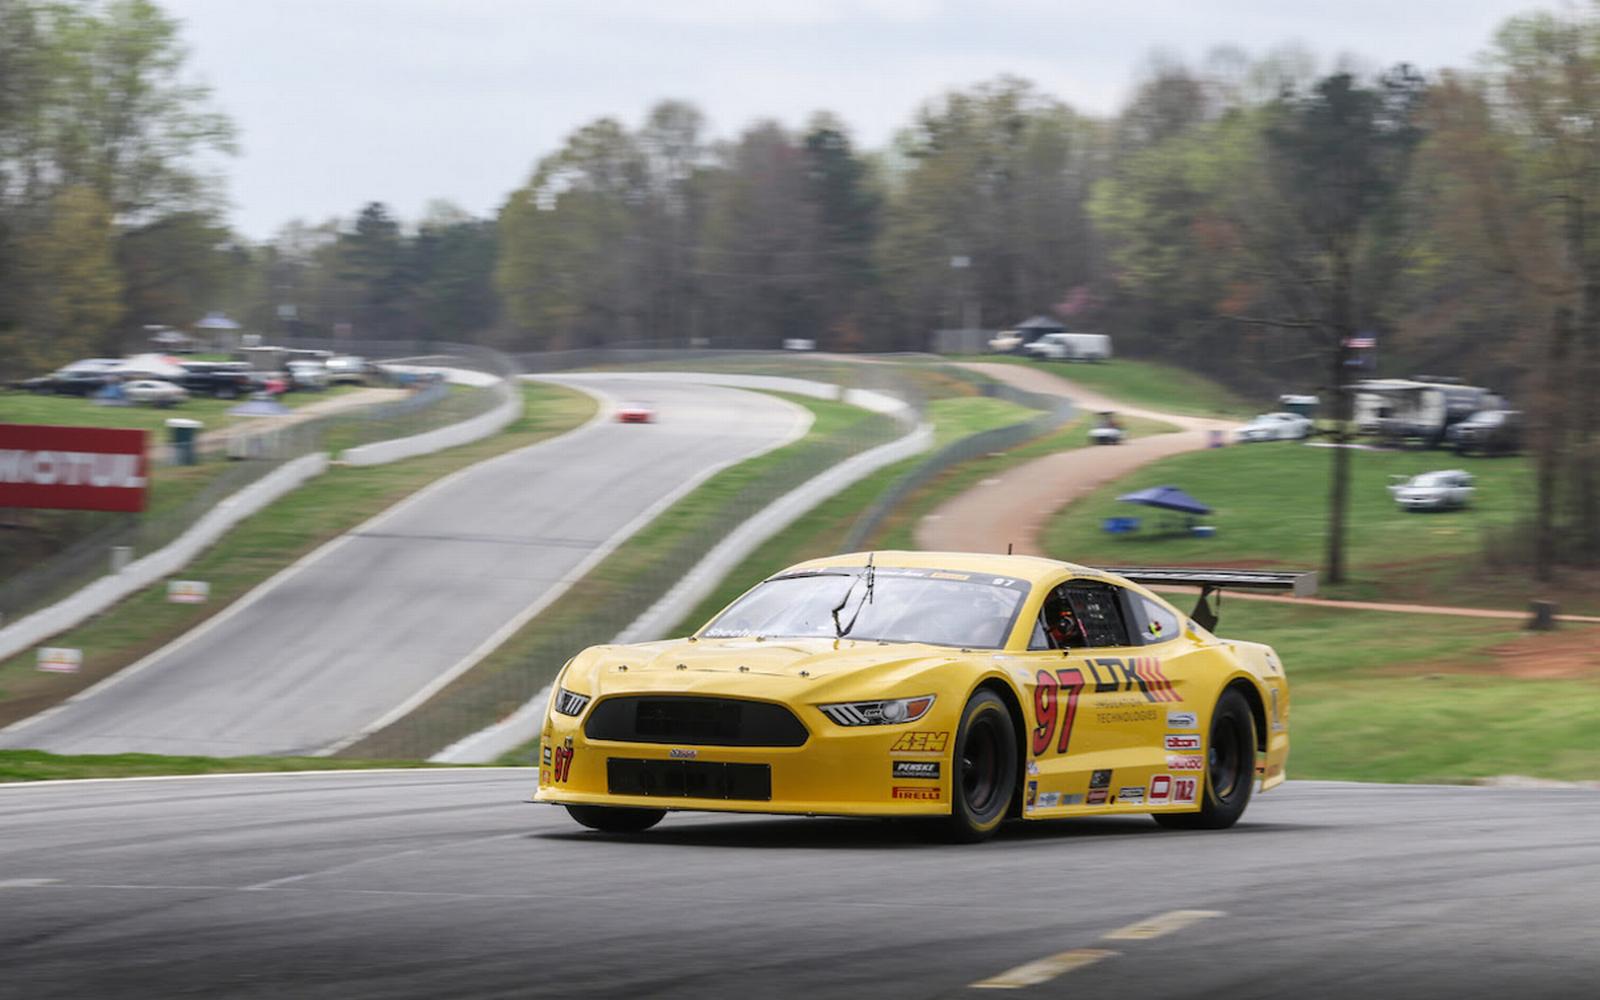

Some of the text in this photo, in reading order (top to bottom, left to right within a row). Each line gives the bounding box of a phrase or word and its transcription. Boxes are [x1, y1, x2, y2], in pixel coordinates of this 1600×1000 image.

[1033, 668, 1085, 757] 97
[1097, 711, 1157, 724] TECHNOLOGIES
[890, 731, 949, 751] AEM
[555, 745, 573, 783] 97
[897, 763, 935, 772] PENSKE
[892, 787, 941, 799] PIRELLI
